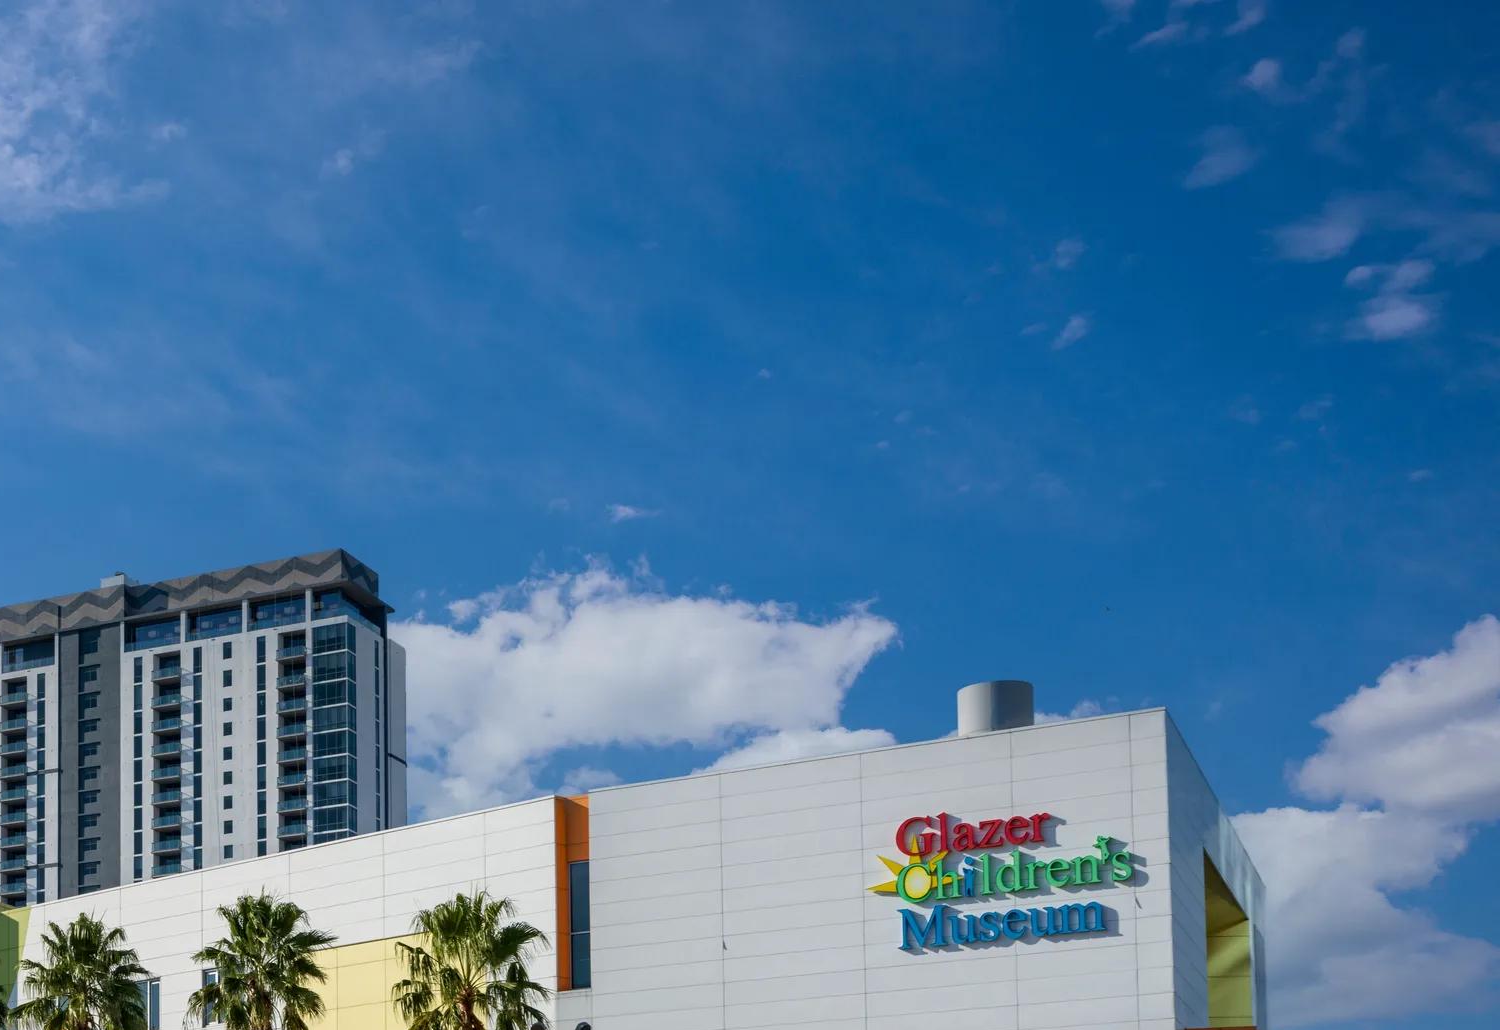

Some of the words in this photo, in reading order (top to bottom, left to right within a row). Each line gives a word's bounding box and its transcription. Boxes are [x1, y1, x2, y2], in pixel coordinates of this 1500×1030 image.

[895, 812, 1051, 857] Glazer
[895, 836, 1134, 904] Children's
[897, 900, 1107, 950] Museum
